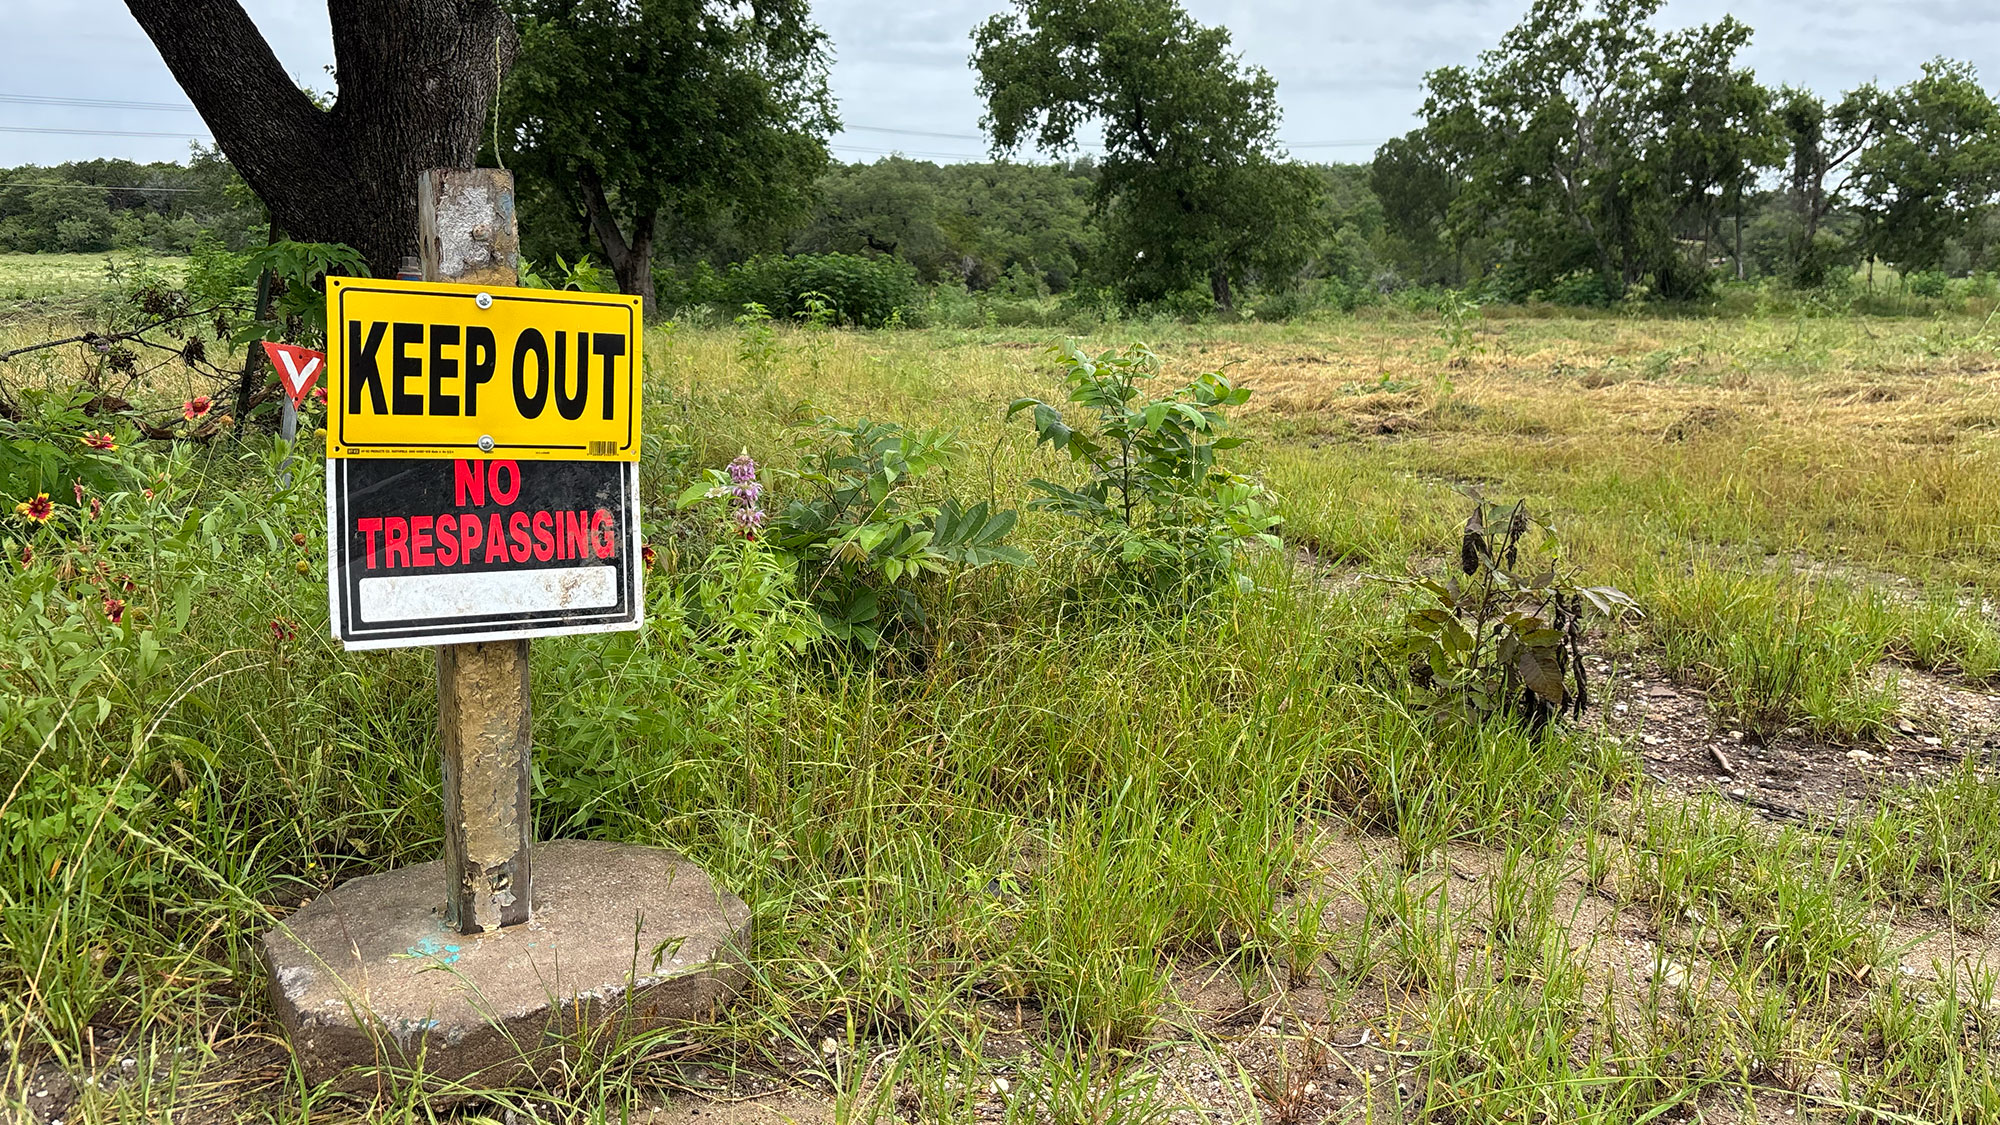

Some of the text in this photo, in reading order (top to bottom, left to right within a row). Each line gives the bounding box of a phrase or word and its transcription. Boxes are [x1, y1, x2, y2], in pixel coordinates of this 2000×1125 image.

[348, 320, 626, 421] KEEP OUT
[454, 458, 521, 507] NO
[357, 508, 615, 569] TRESPASSING
